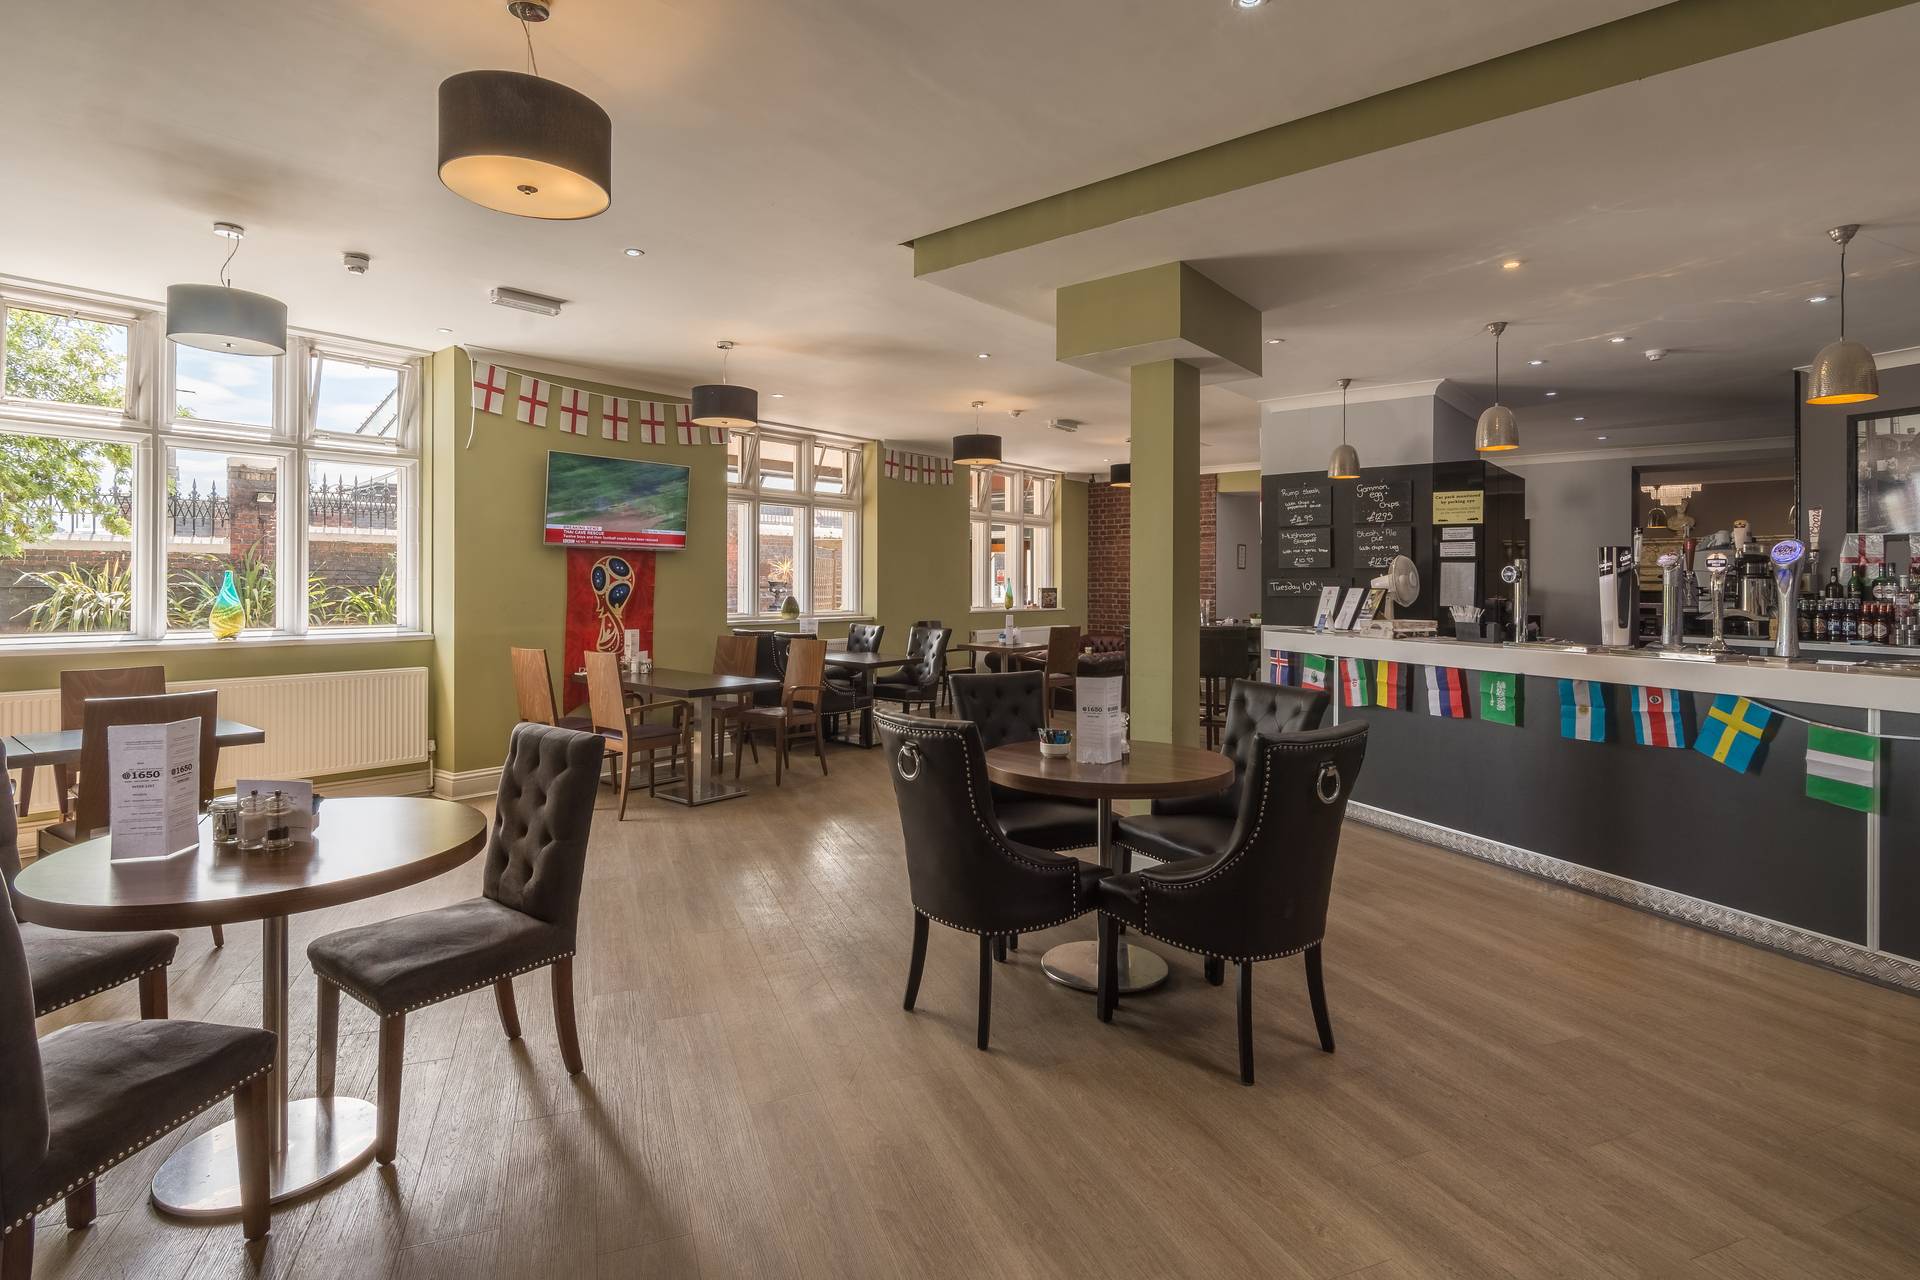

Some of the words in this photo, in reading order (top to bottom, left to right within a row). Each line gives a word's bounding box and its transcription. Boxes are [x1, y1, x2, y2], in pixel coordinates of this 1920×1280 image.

[1269, 582, 1301, 594] Tuesday
[121, 770, 161, 780] @1650
[171, 763, 193, 775] @1650
